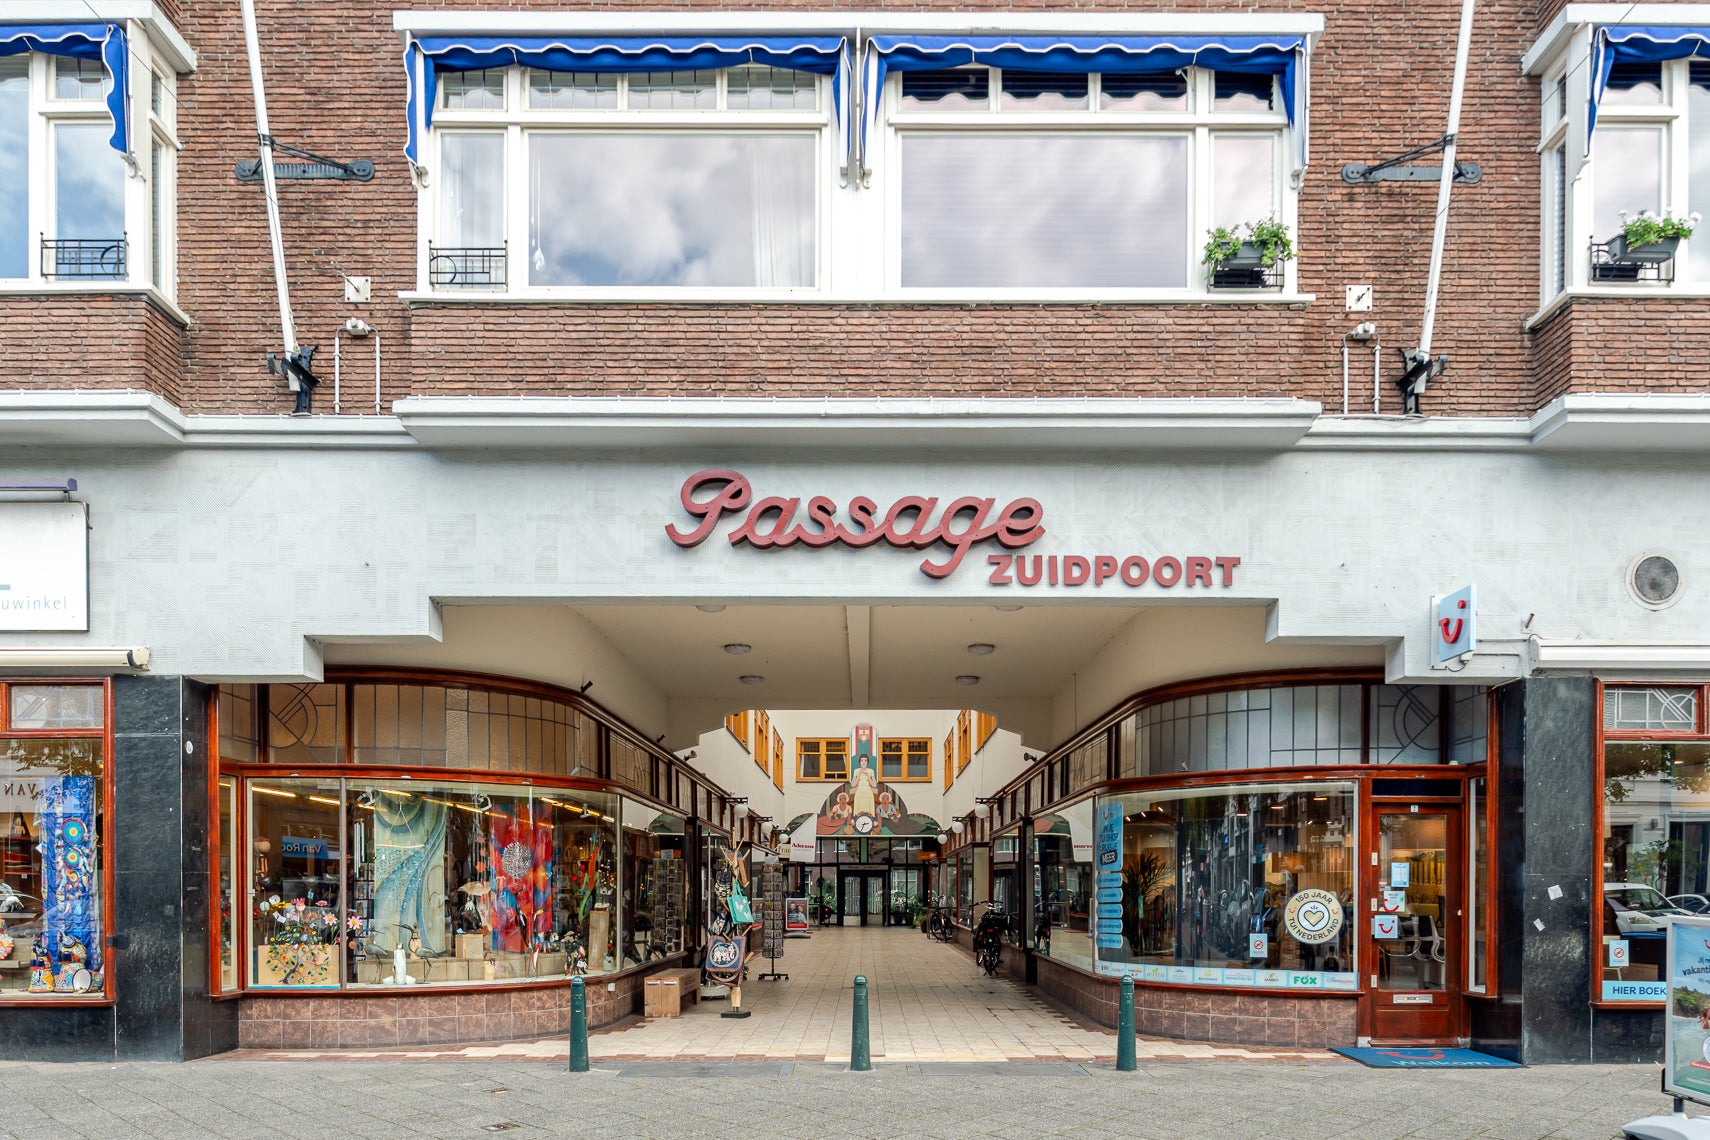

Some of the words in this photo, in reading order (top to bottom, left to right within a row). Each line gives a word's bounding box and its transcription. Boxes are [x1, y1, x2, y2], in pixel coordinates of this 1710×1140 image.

[664, 468, 1046, 580] Passage
[988, 555, 1241, 587] ZUIDPOORT
[1, 595, 67, 610] uwinkel
[1102, 852, 1116, 864] MEER
[1296, 892, 1309, 903] 150
[1311, 892, 1333, 904] JAAR
[1289, 917, 1298, 931] TUI
[1296, 918, 1339, 941] NEDERLAND
[1293, 975, 1317, 985] FOX
[1612, 986, 1637, 995] HIER
[1638, 986, 1667, 995] BOEK
